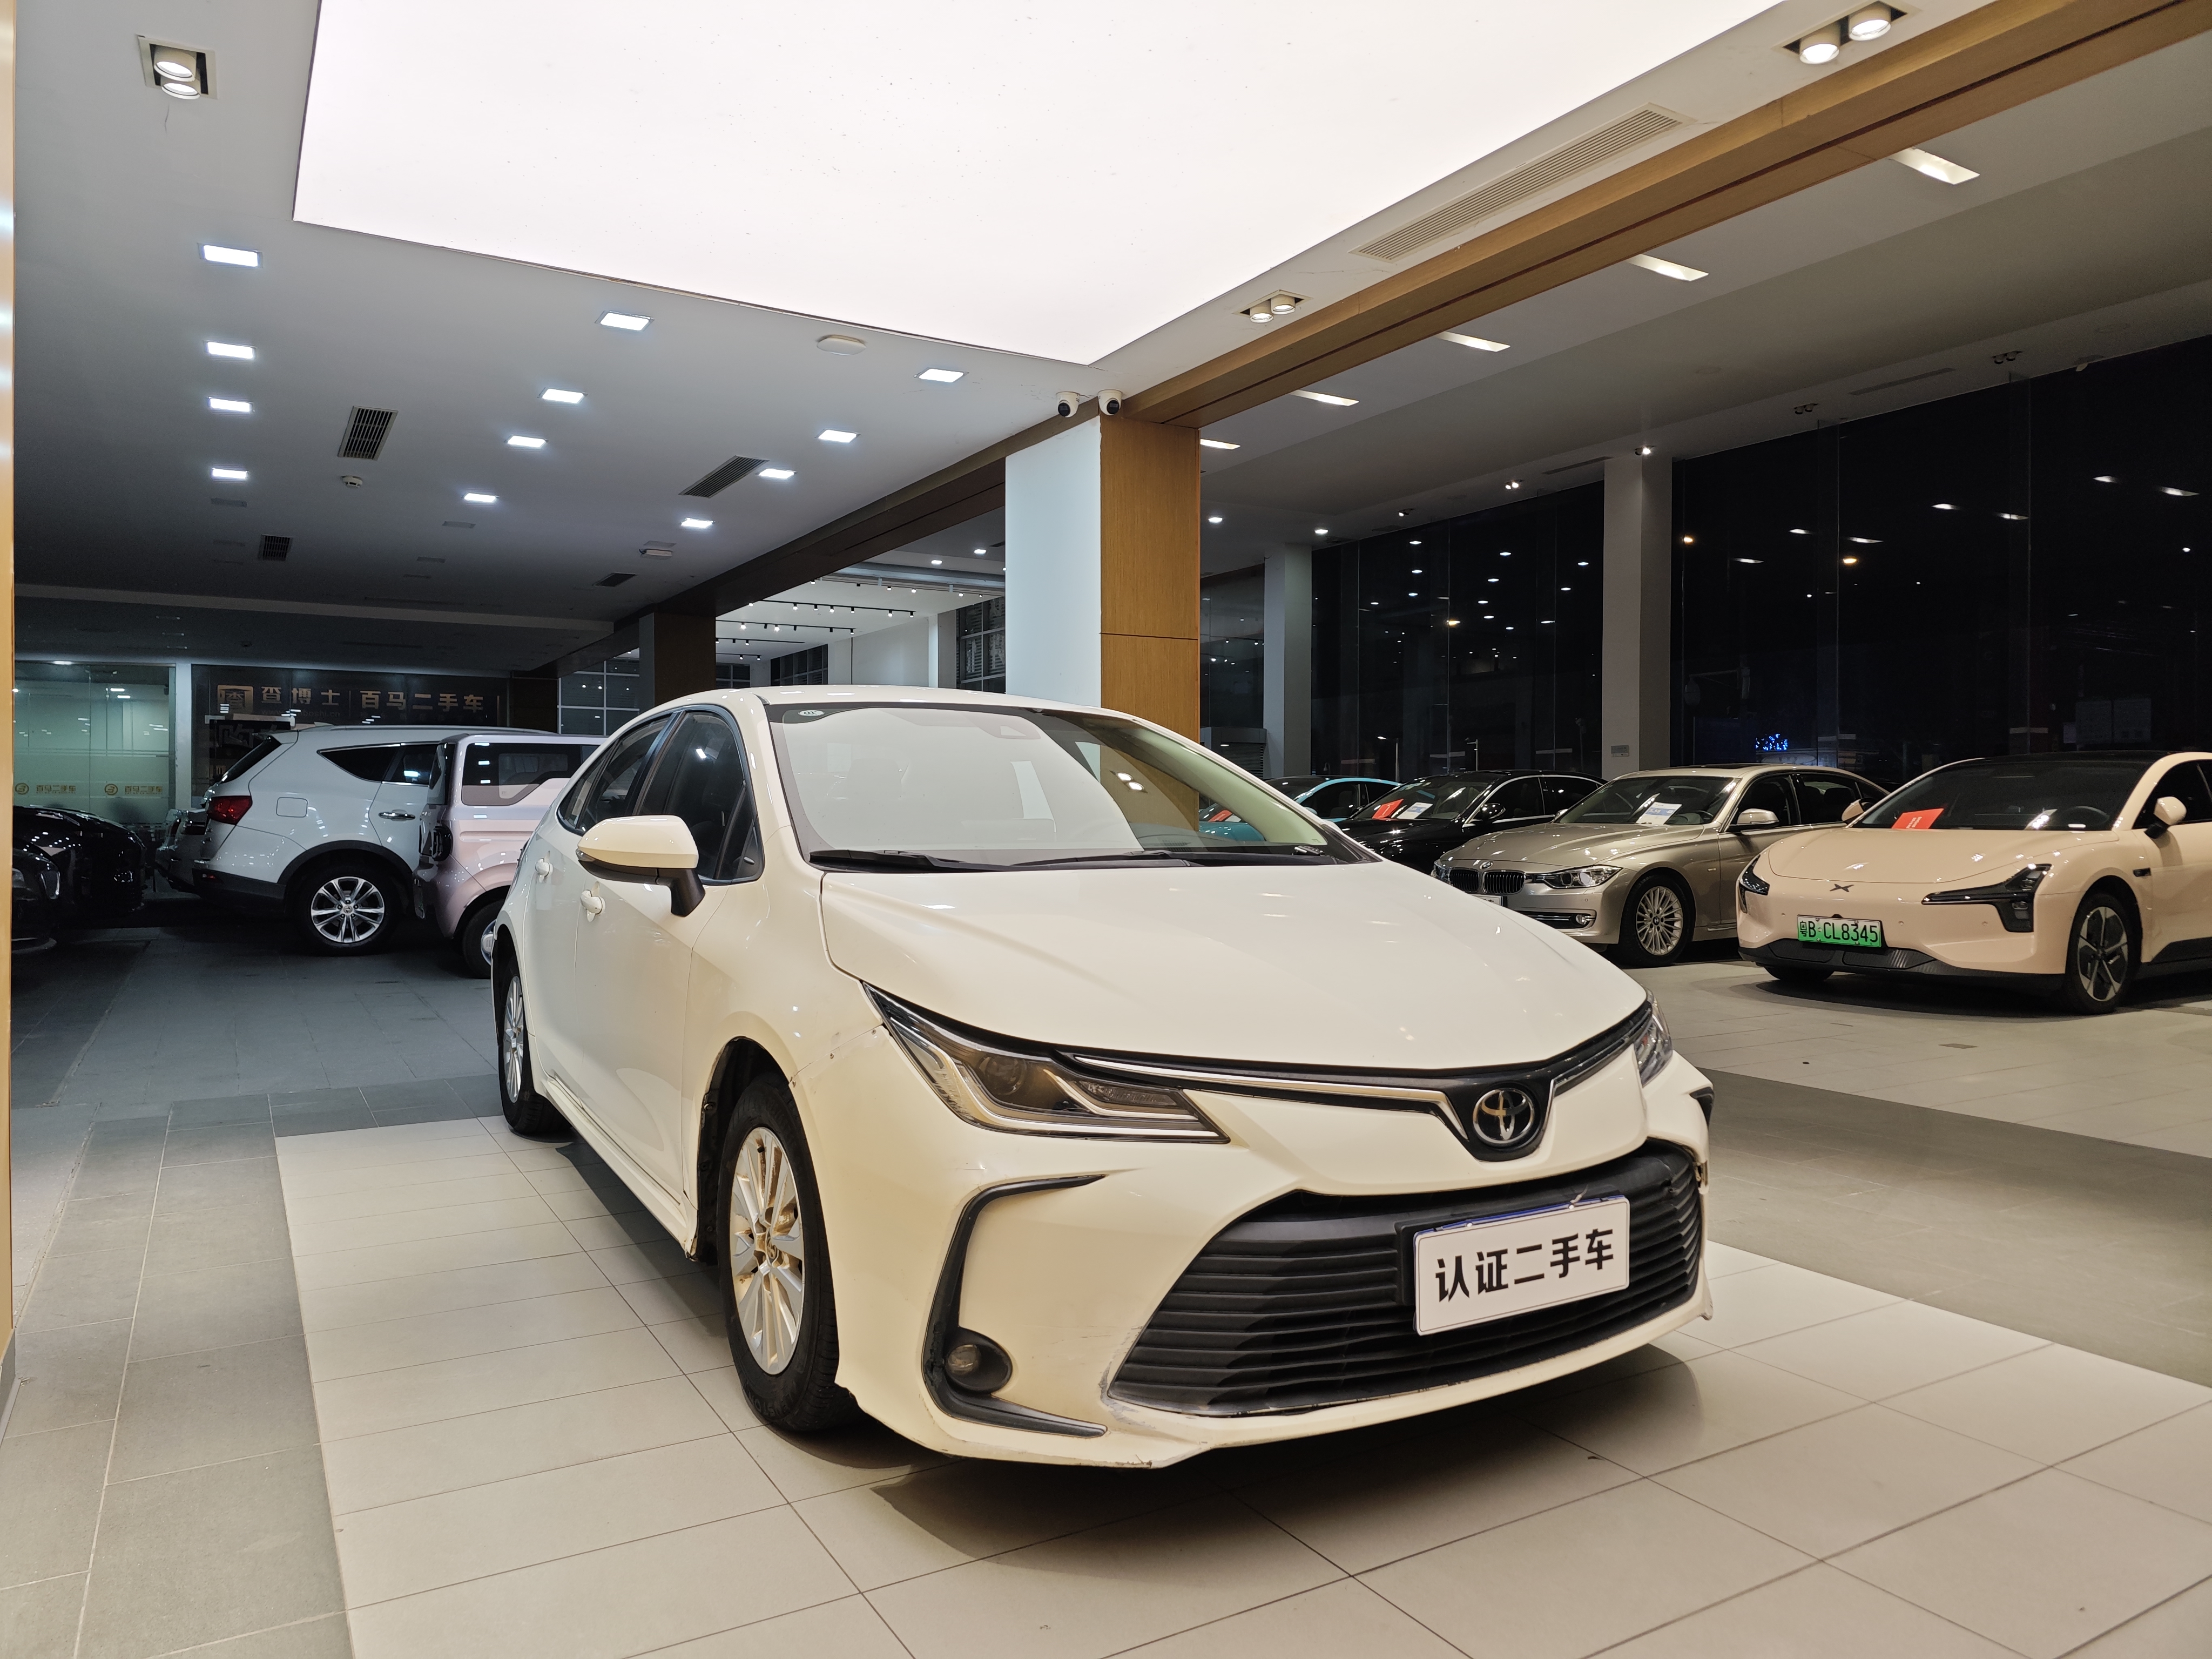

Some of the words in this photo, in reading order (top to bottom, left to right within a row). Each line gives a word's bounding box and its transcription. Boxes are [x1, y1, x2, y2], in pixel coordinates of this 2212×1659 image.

[261, 686, 340, 706] 查博士
[360, 690, 484, 713] 百马二手车
[1435, 1228, 1614, 1302] 认证二手车
